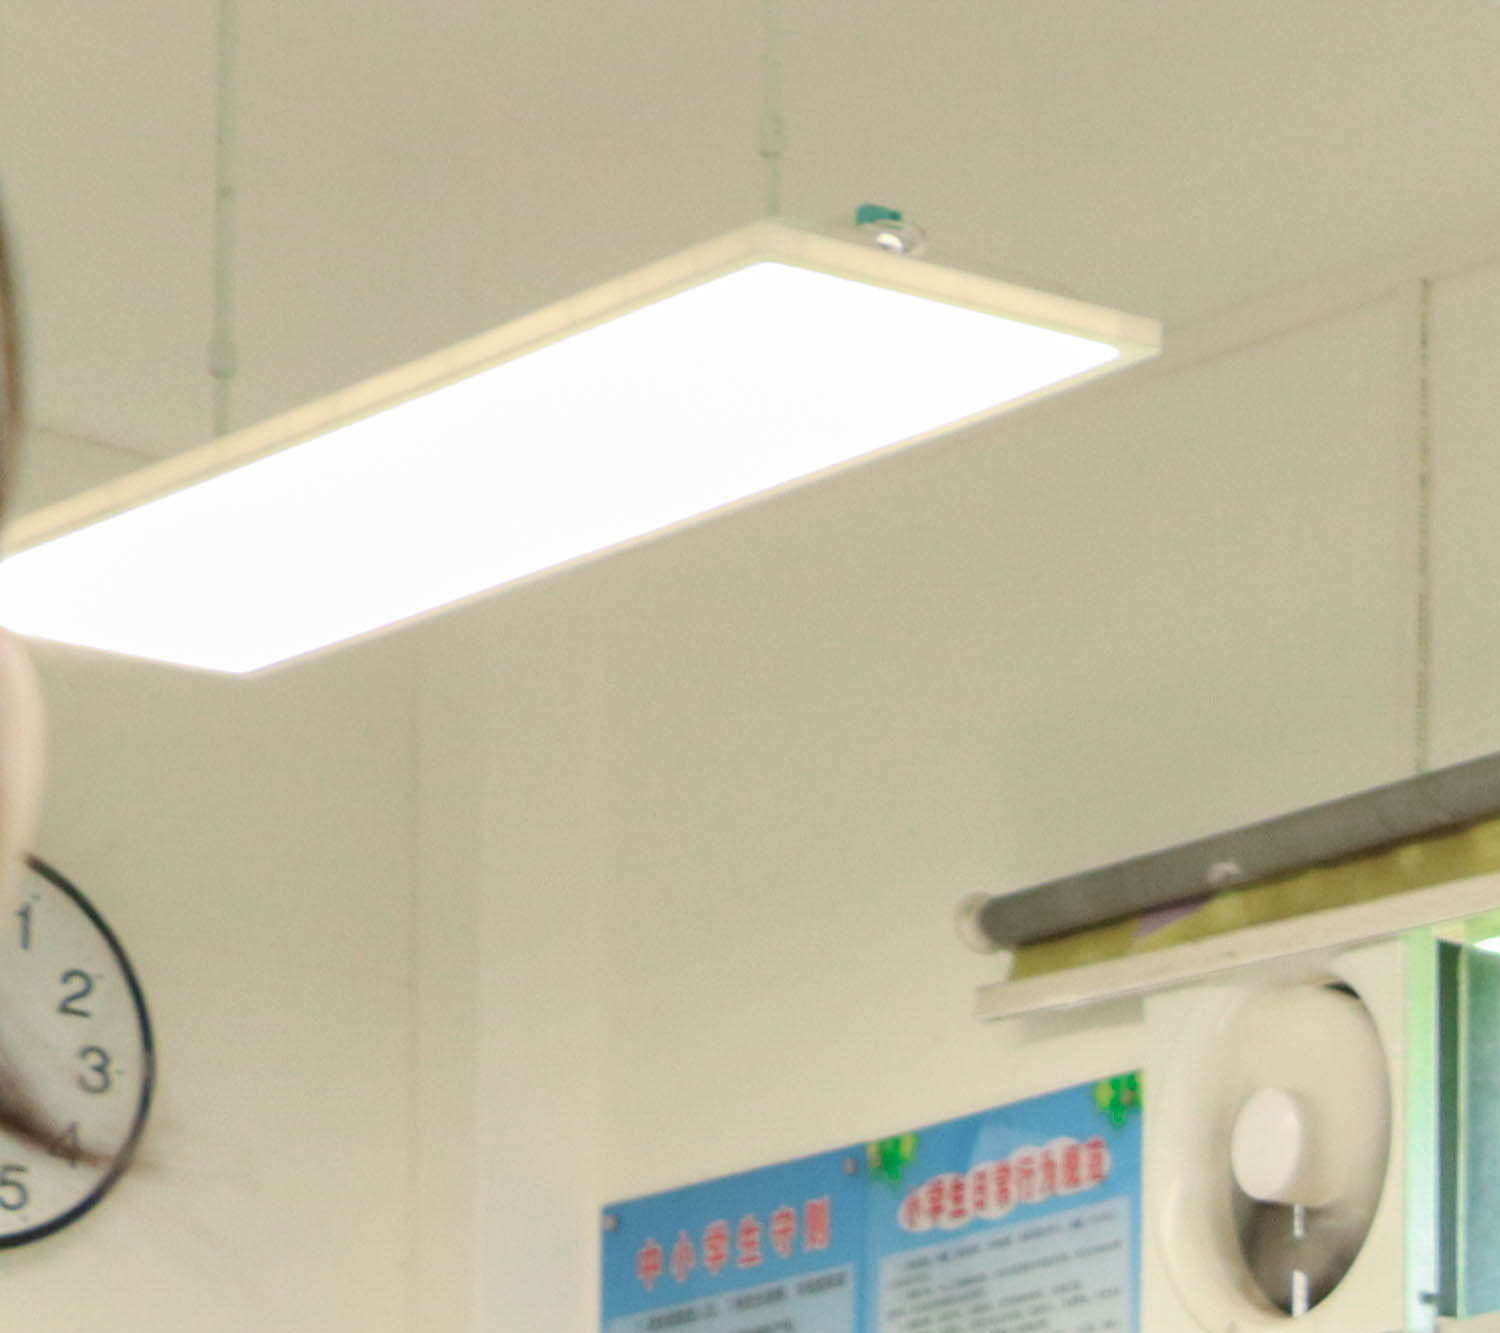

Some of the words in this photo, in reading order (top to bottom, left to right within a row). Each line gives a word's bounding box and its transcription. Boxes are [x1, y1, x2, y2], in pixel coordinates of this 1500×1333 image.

[15, 903, 31, 950] 1
[57, 969, 94, 1018] 2
[76, 1046, 112, 1094] 3
[0, 1164, 29, 1211] 5
[636, 1195, 832, 1292] 中小学生守则
